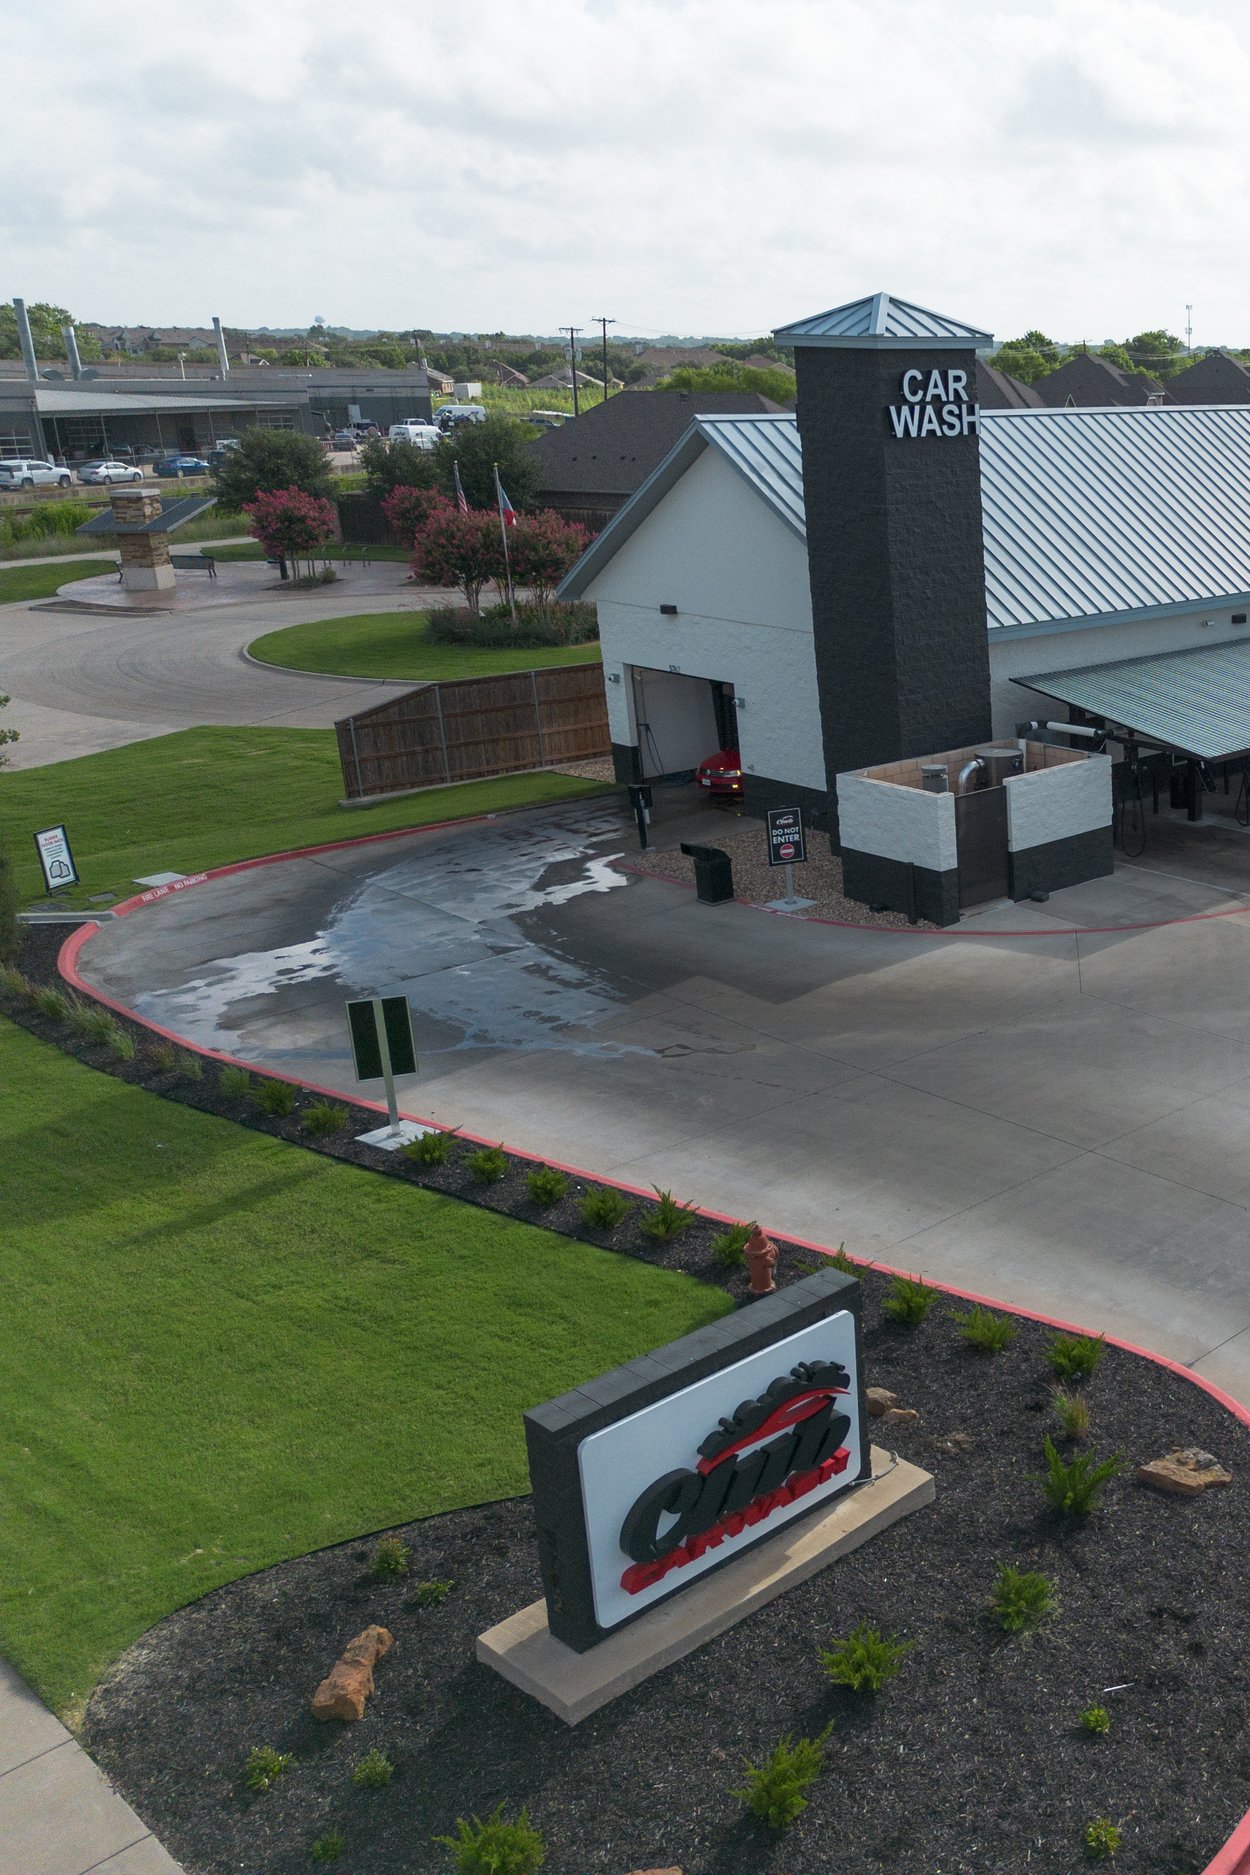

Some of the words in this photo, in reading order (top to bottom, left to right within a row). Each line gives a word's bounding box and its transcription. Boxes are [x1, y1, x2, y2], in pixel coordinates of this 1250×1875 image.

[903, 369, 969, 403] CAR
[889, 403, 982, 438] WASH
[772, 828, 784, 836] DO
[784, 827, 800, 835] NOT
[773, 834, 800, 844] ENTER
[153, 886, 171, 898] LANE
[173, 882, 184, 890] NO
[619, 1396, 851, 1563] Club
